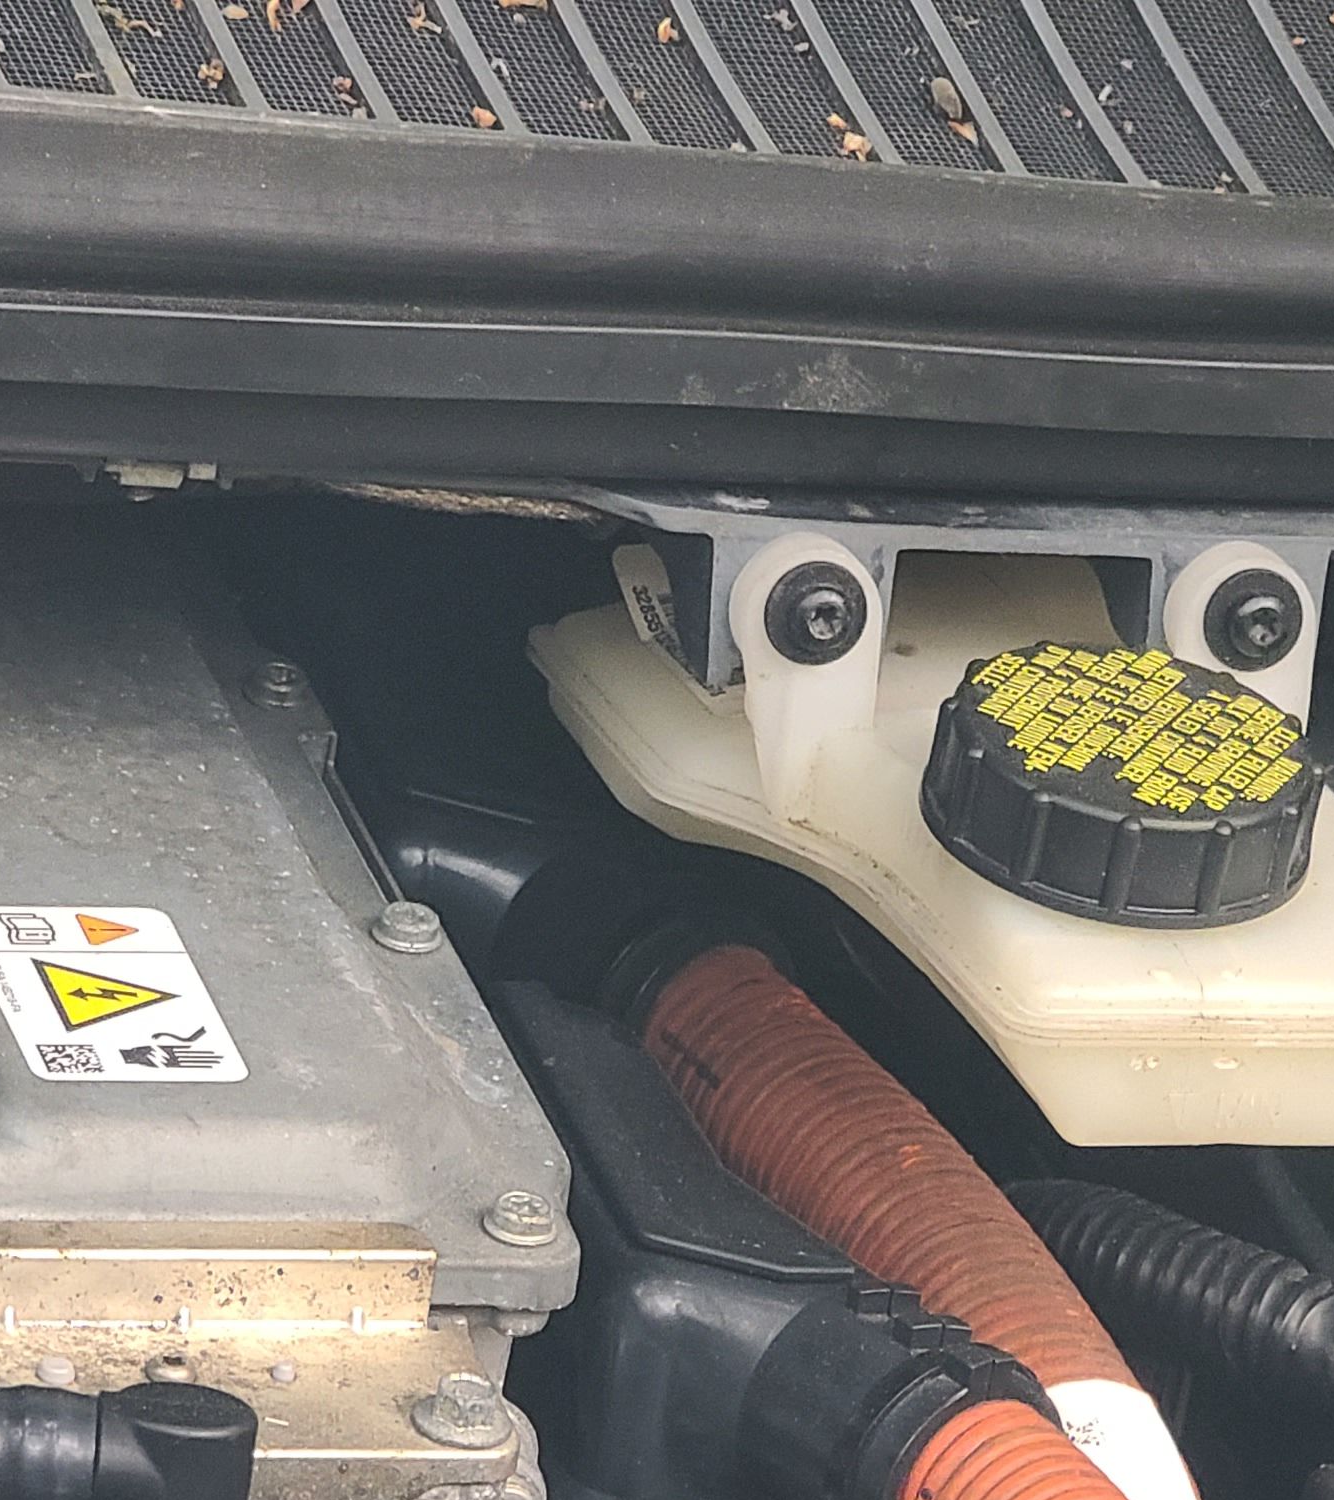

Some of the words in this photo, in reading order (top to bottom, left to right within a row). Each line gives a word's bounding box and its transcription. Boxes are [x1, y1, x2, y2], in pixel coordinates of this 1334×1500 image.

[1030, 644, 1071, 670] D'UN
[1049, 665, 1078, 680] 4
[1063, 649, 1100, 673] DOT
[1084, 648, 1138, 683] PLOYER
[1127, 648, 1172, 680] AVANT
[979, 662, 1047, 720] CONTENANT
[1062, 675, 1101, 703] QUE
[1094, 686, 1126, 706] LE
[1109, 673, 1143, 693] DE
[1121, 663, 1186, 712] NETTOYER
[1208, 689, 1233, 703] A
[997, 673, 1069, 732] PROVENANT
[1047, 695, 1080, 717] DU
[1105, 707, 1139, 727] LE
[1170, 698, 1223, 735] SEALED
[1222, 693, 1265, 722] ONLY
[1007, 709, 1064, 754] LIQUIDE
[1101, 688, 1192, 762] AVERTISSEMENT:
[1191, 734, 1221, 748] 4
[1203, 713, 1240, 740] DOT
[1233, 705, 1287, 744] BEFORE
[1057, 722, 1122, 772] BOUCHON
[1115, 729, 1186, 784] CONTAINER.
[1162, 742, 1209, 775] FLUID
[1253, 724, 1300, 760] CLEAN
[1181, 736, 1252, 789] REMOVING.
[1218, 752, 1270, 790] FILLER
[1241, 755, 1303, 802] WARNING:
[1132, 769, 1180, 806] FROM
[1159, 785, 1200, 813] USE
[1199, 784, 1236, 811] CAP
